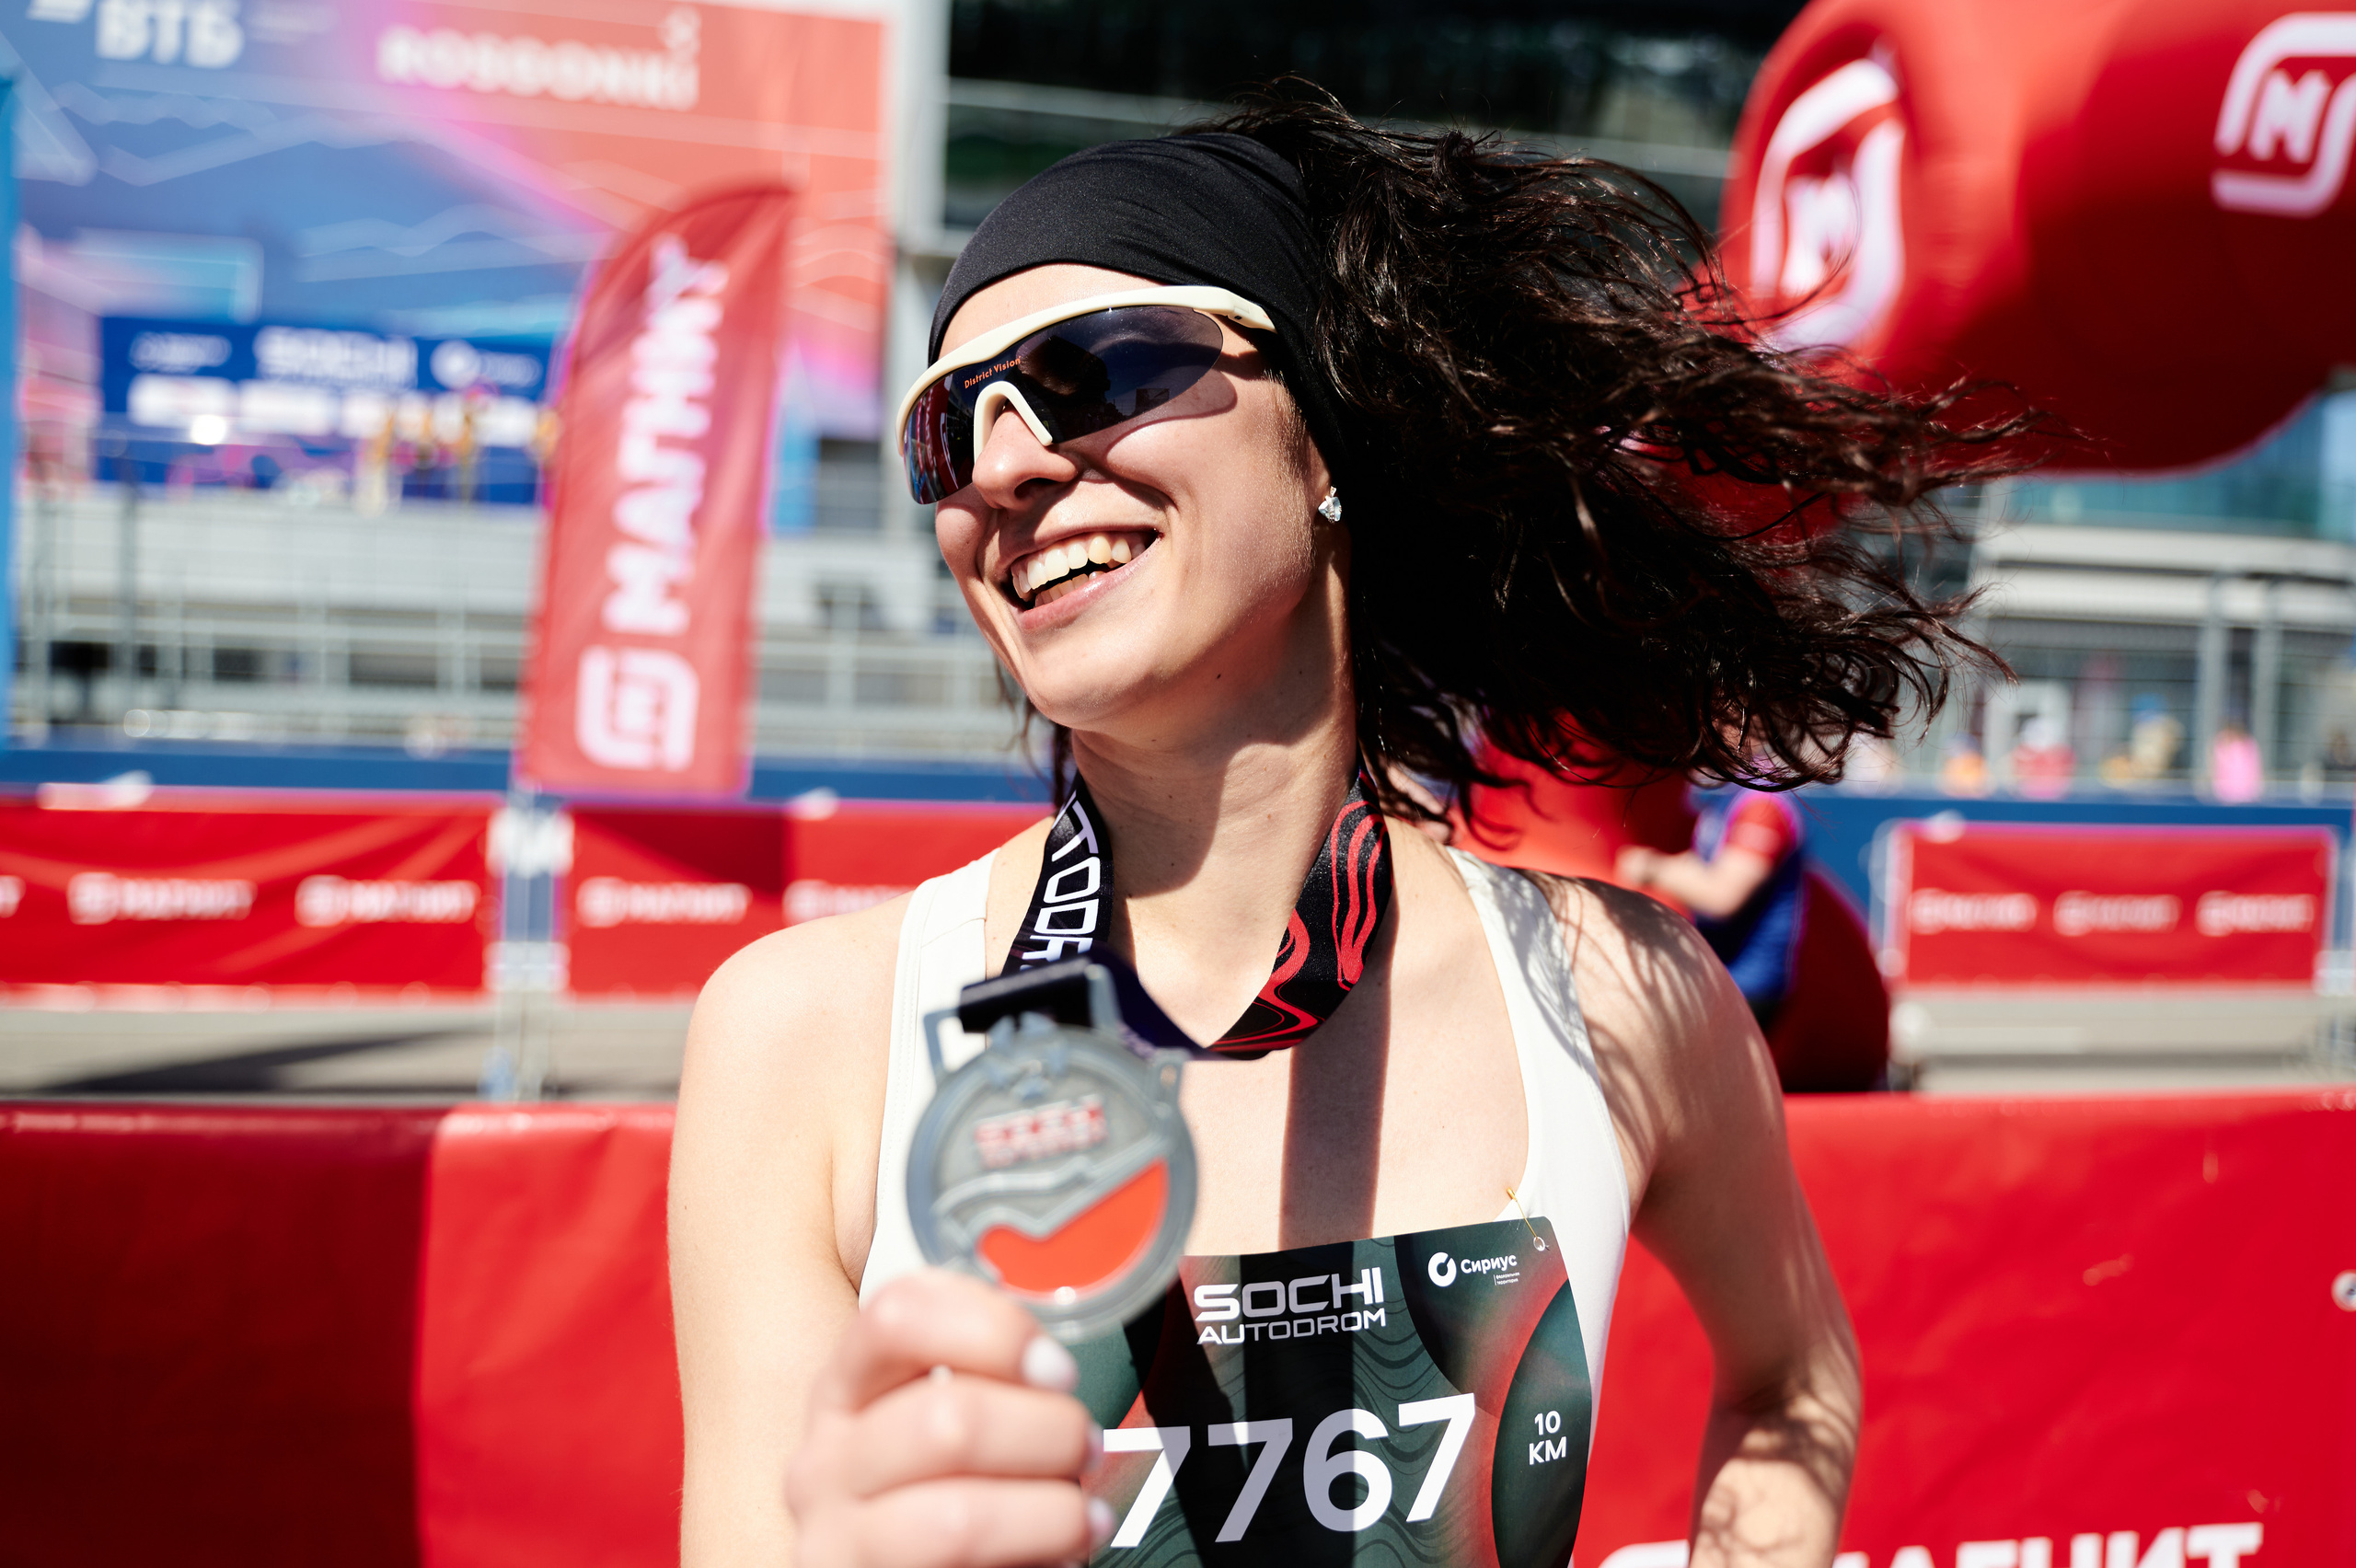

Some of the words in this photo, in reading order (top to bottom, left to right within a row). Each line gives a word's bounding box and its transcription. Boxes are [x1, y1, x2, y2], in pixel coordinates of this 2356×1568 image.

[964, 367, 993, 389] District
[994, 358, 1021, 373] Vision
[603, 234, 727, 636] МАГНИТ
[1460, 1254, 1518, 1274] Сириус
[1194, 1266, 1385, 1322] SOCHI
[1196, 1308, 1387, 1345] AUTODROM
[1534, 1410, 1562, 1436] 10
[1529, 1435, 1567, 1466] KM
[1103, 1392, 1476, 1550] 7767
